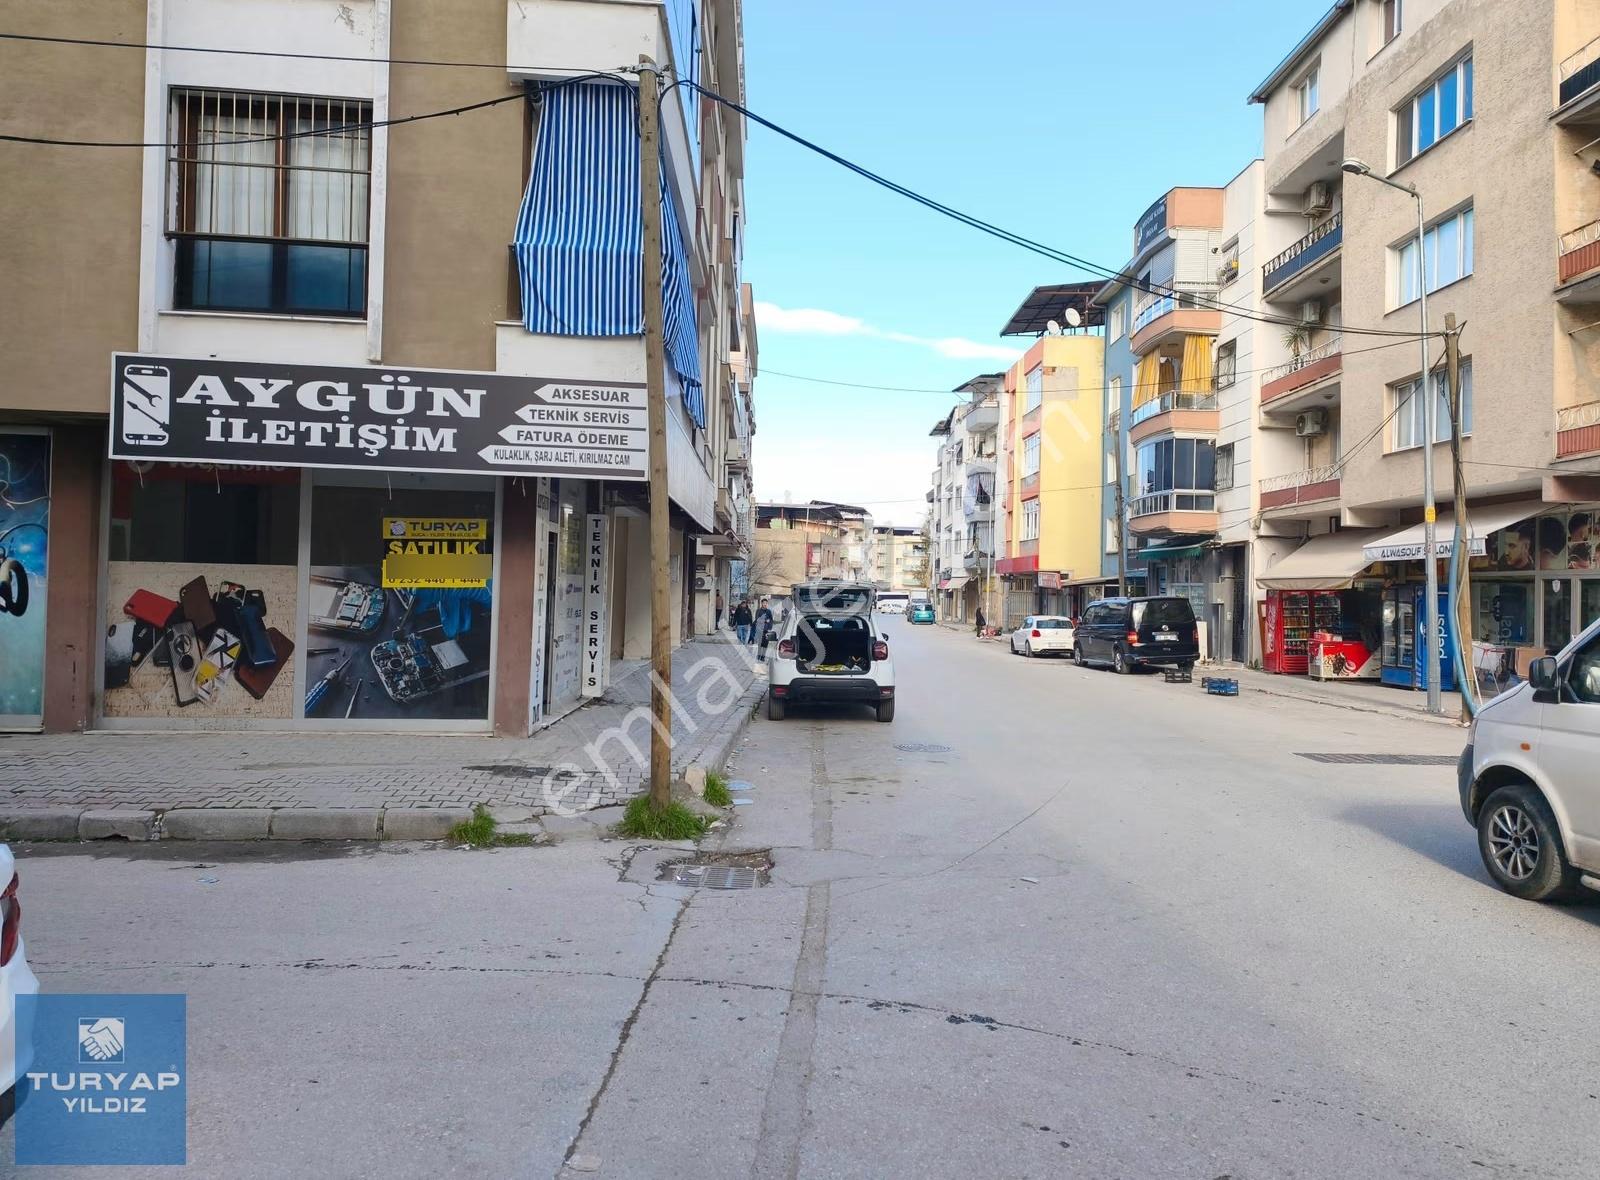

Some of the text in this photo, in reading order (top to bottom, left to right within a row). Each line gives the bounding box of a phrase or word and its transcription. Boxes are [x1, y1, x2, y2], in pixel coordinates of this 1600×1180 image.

[176, 374, 487, 418] AYGÜN
[552, 388, 630, 403] AKSESUAR
[529, 408, 630, 424] TEKNİK SERVİS
[205, 409, 458, 457] İLETİŞİM
[516, 430, 629, 446] FATURA ÖDEME
[494, 449, 630, 466] KULAKLIK, ŞARJ ALETİ, KIRILMAZ CAM
[409, 522, 480, 531] TURYAP
[388, 541, 480, 555] SATILIK
[1380, 546, 1421, 558] ALWASOUF
[590, 519, 601, 594] TEKNİK
[587, 610, 599, 687] SERVİS
